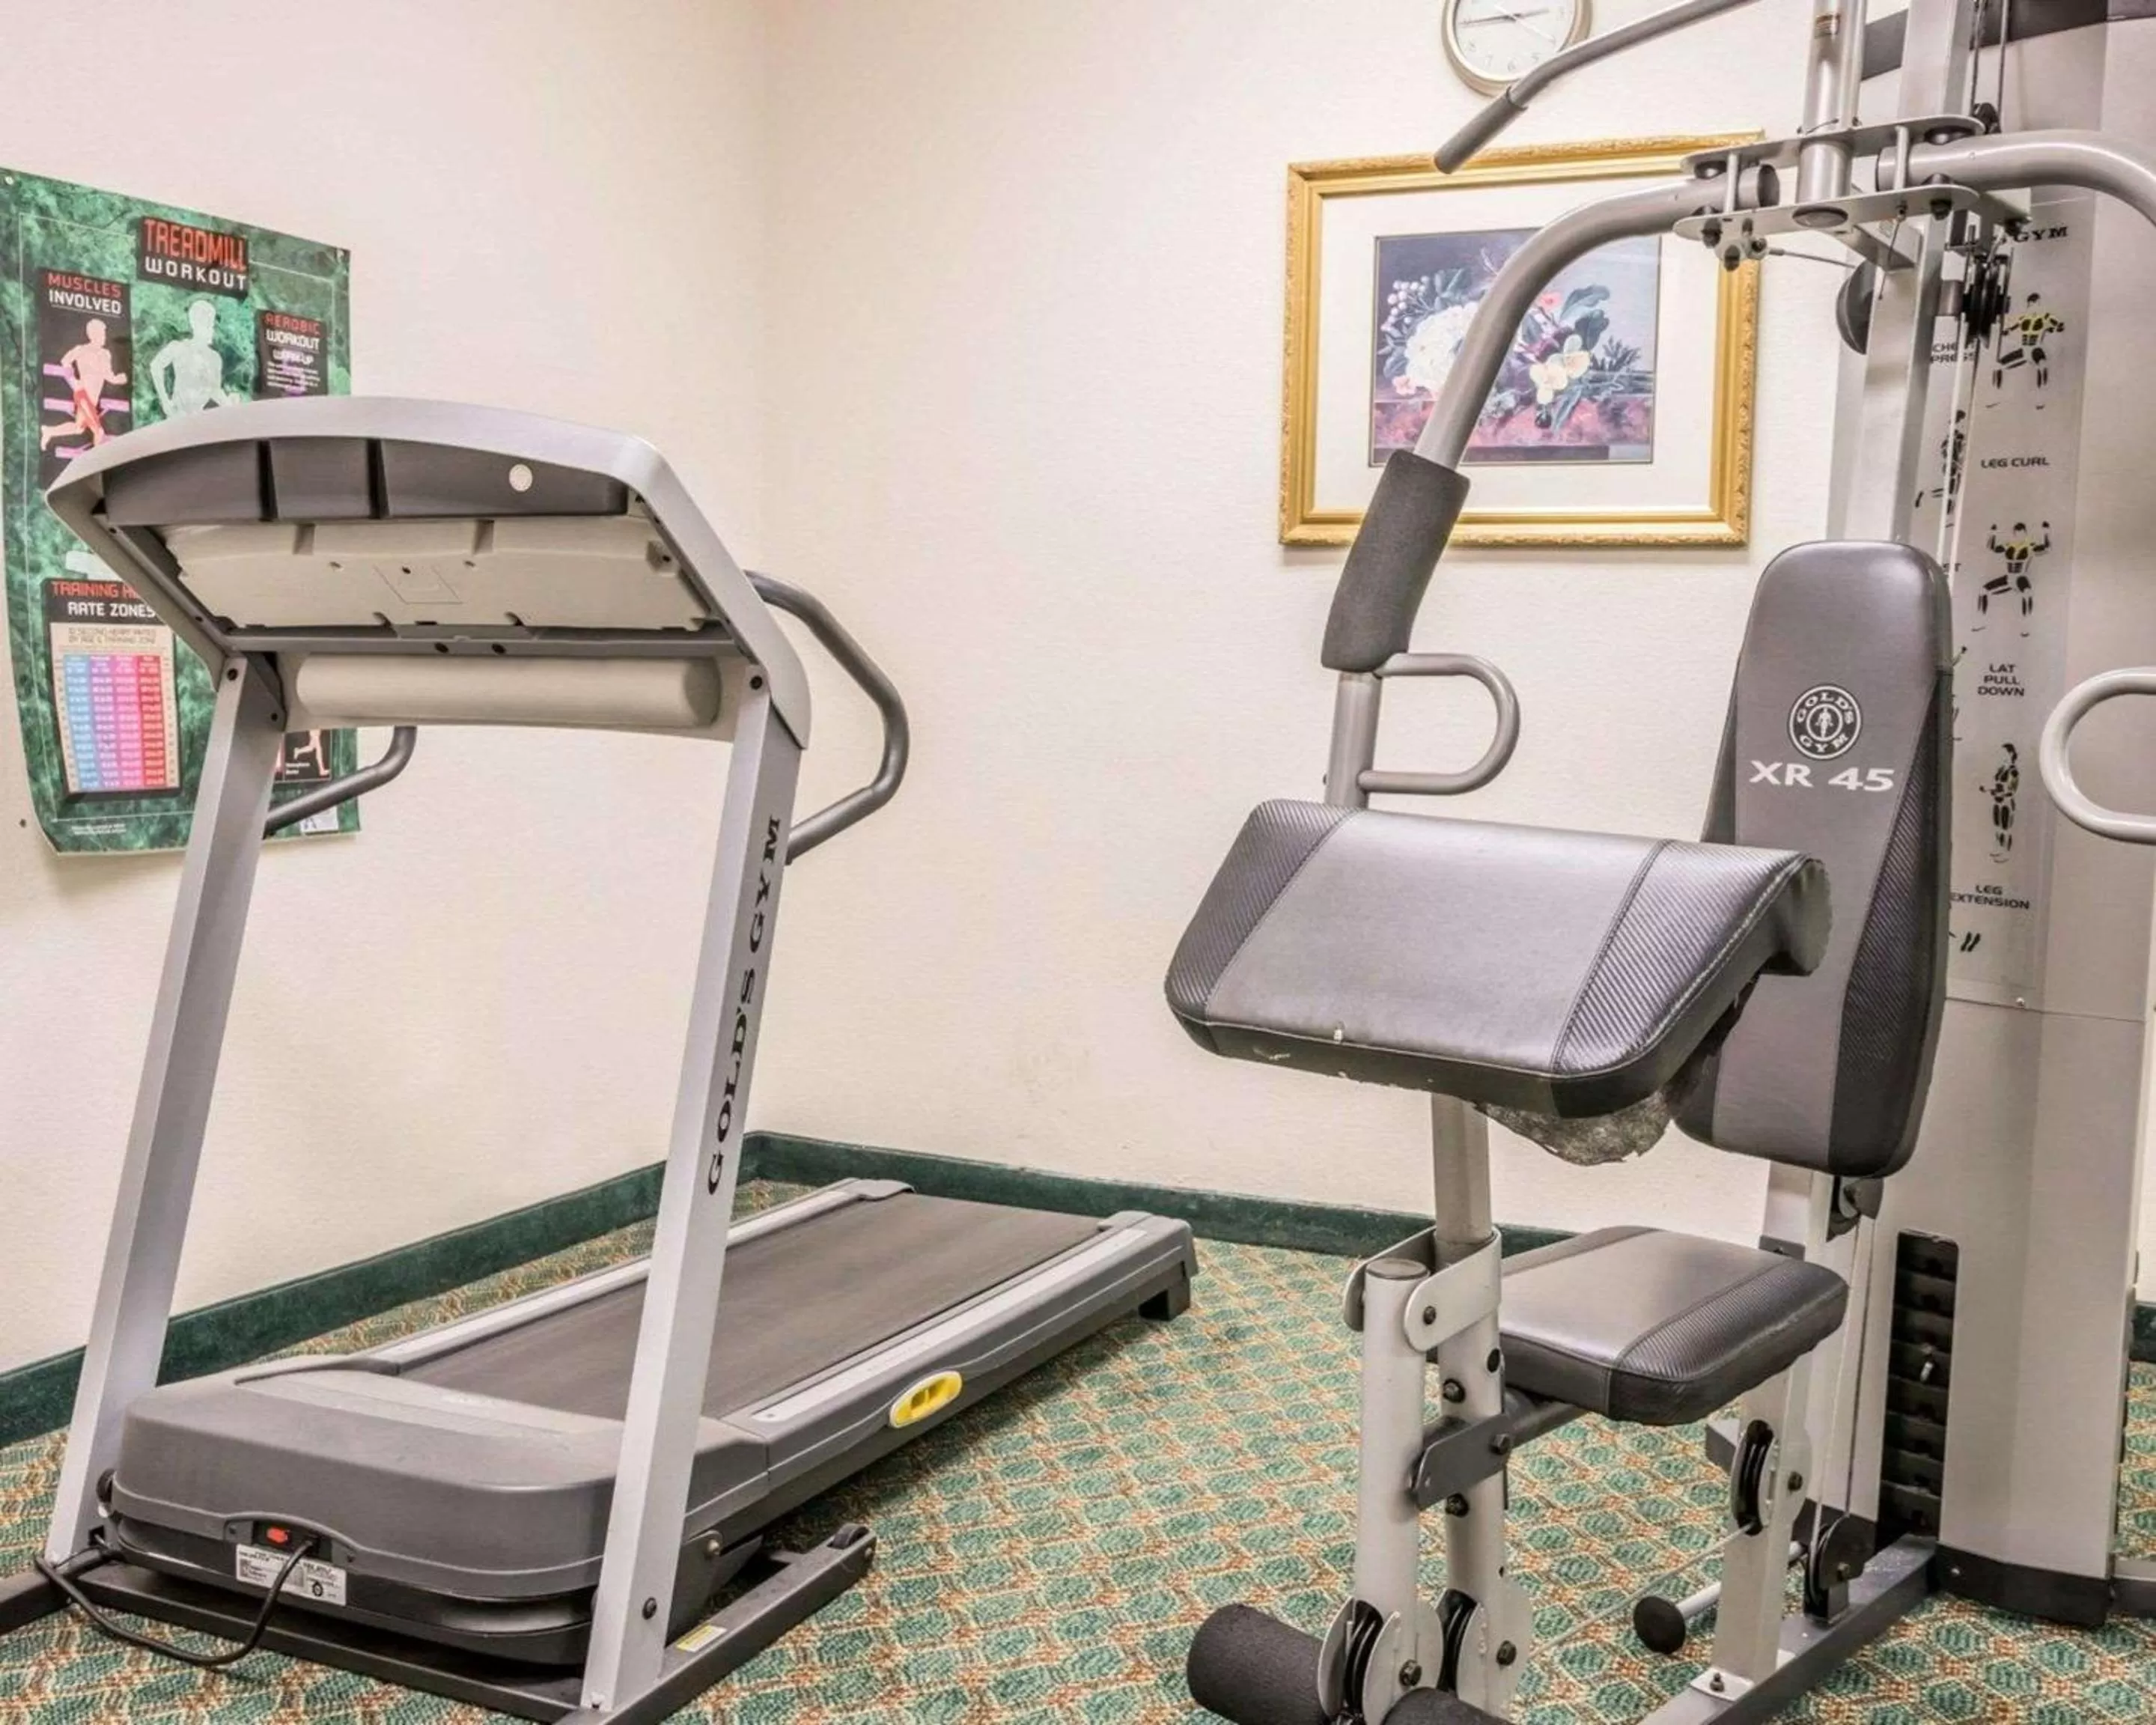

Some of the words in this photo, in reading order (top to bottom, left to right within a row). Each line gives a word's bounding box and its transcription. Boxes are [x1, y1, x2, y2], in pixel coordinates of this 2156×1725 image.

[2014, 226, 2068, 243] GYM
[144, 219, 247, 273] TREADMILL
[144, 255, 247, 291] WORKOUT
[48, 273, 122, 298] MUSCLES
[49, 288, 122, 314] INVOLVED
[264, 312, 322, 338] AEROBIC
[265, 329, 320, 351] WORKOUT
[1980, 457, 2008, 469] LEG
[2011, 456, 2050, 468] CURL
[52, 582, 119, 597] TRAINING
[67, 601, 105, 616] RATE
[110, 603, 156, 618] ZONES
[1988, 663, 2016, 673] LAT
[1984, 675, 2021, 684] PULL
[1977, 686, 2024, 696] DOWN
[1797, 692, 1854, 725] GOLD'S
[1799, 733, 1849, 753] GYM
[1749, 760, 1814, 788] XR
[1828, 767, 1895, 792] 45
[1975, 884, 2003, 895] LEG
[1949, 892, 2030, 909] EXTENSION
[707, 968, 755, 1196] GOLD'S
[749, 814, 781, 954] GYM
